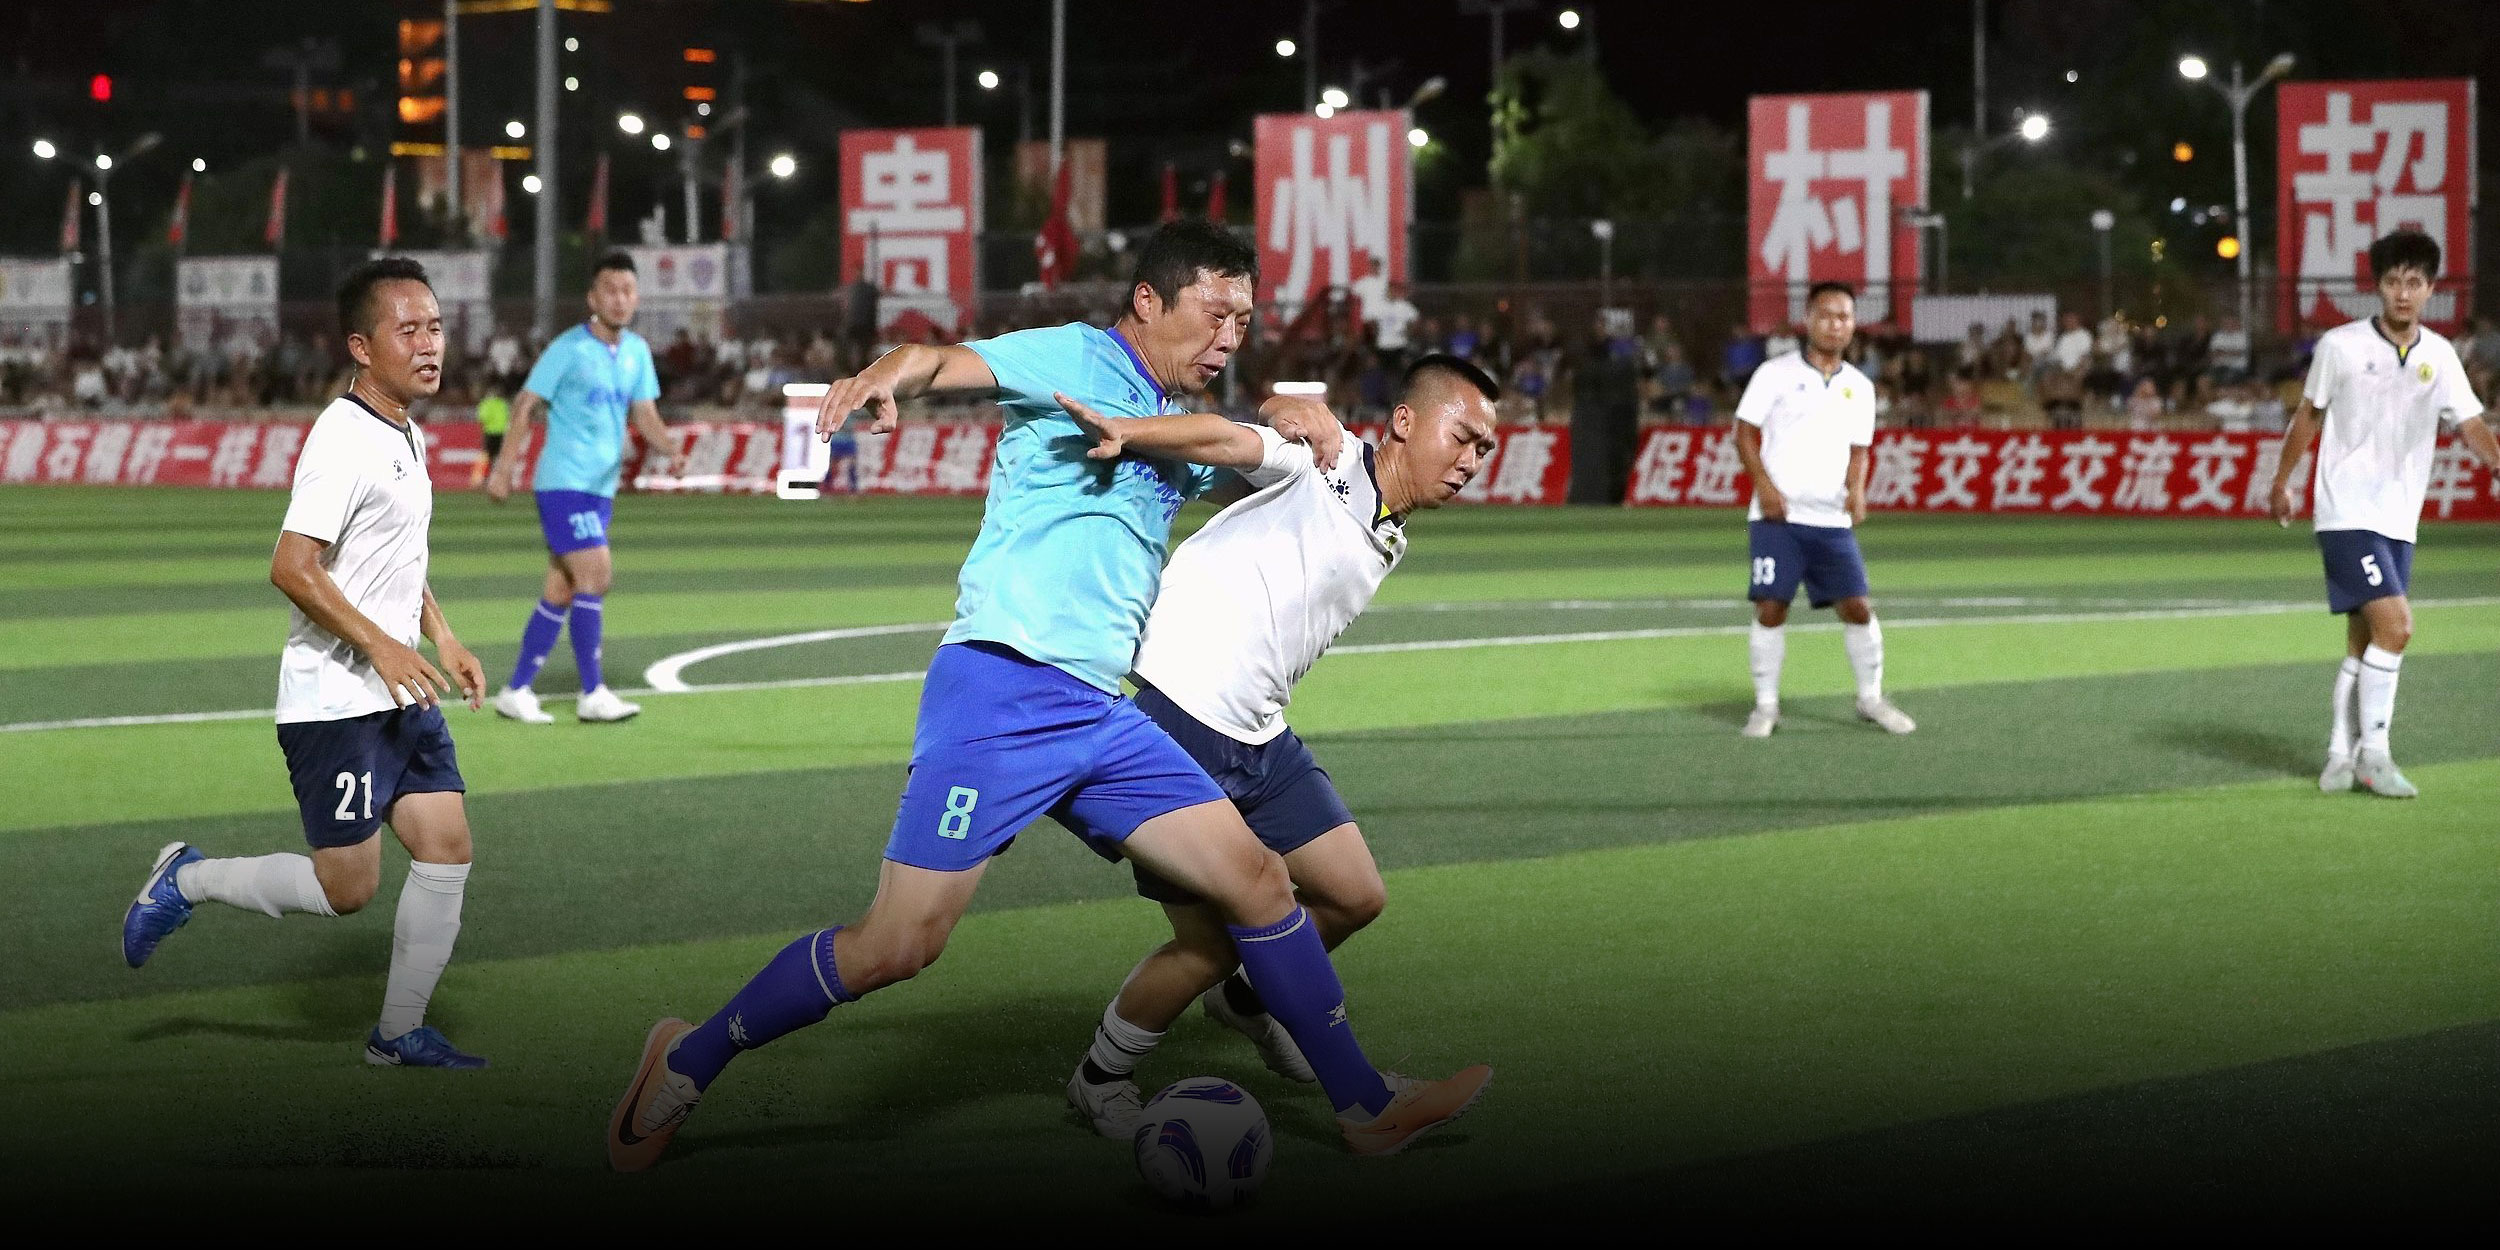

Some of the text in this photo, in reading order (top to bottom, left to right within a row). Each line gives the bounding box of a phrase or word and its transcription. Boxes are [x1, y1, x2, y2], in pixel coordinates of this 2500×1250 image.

[848, 135, 966, 332] 贵
[1269, 121, 1391, 325] 州
[1761, 102, 1906, 323] 村
[2294, 91, 2456, 322] 超
[2360, 553, 2384, 587] 5
[335, 771, 374, 821] 21
[937, 785, 979, 840] 8
